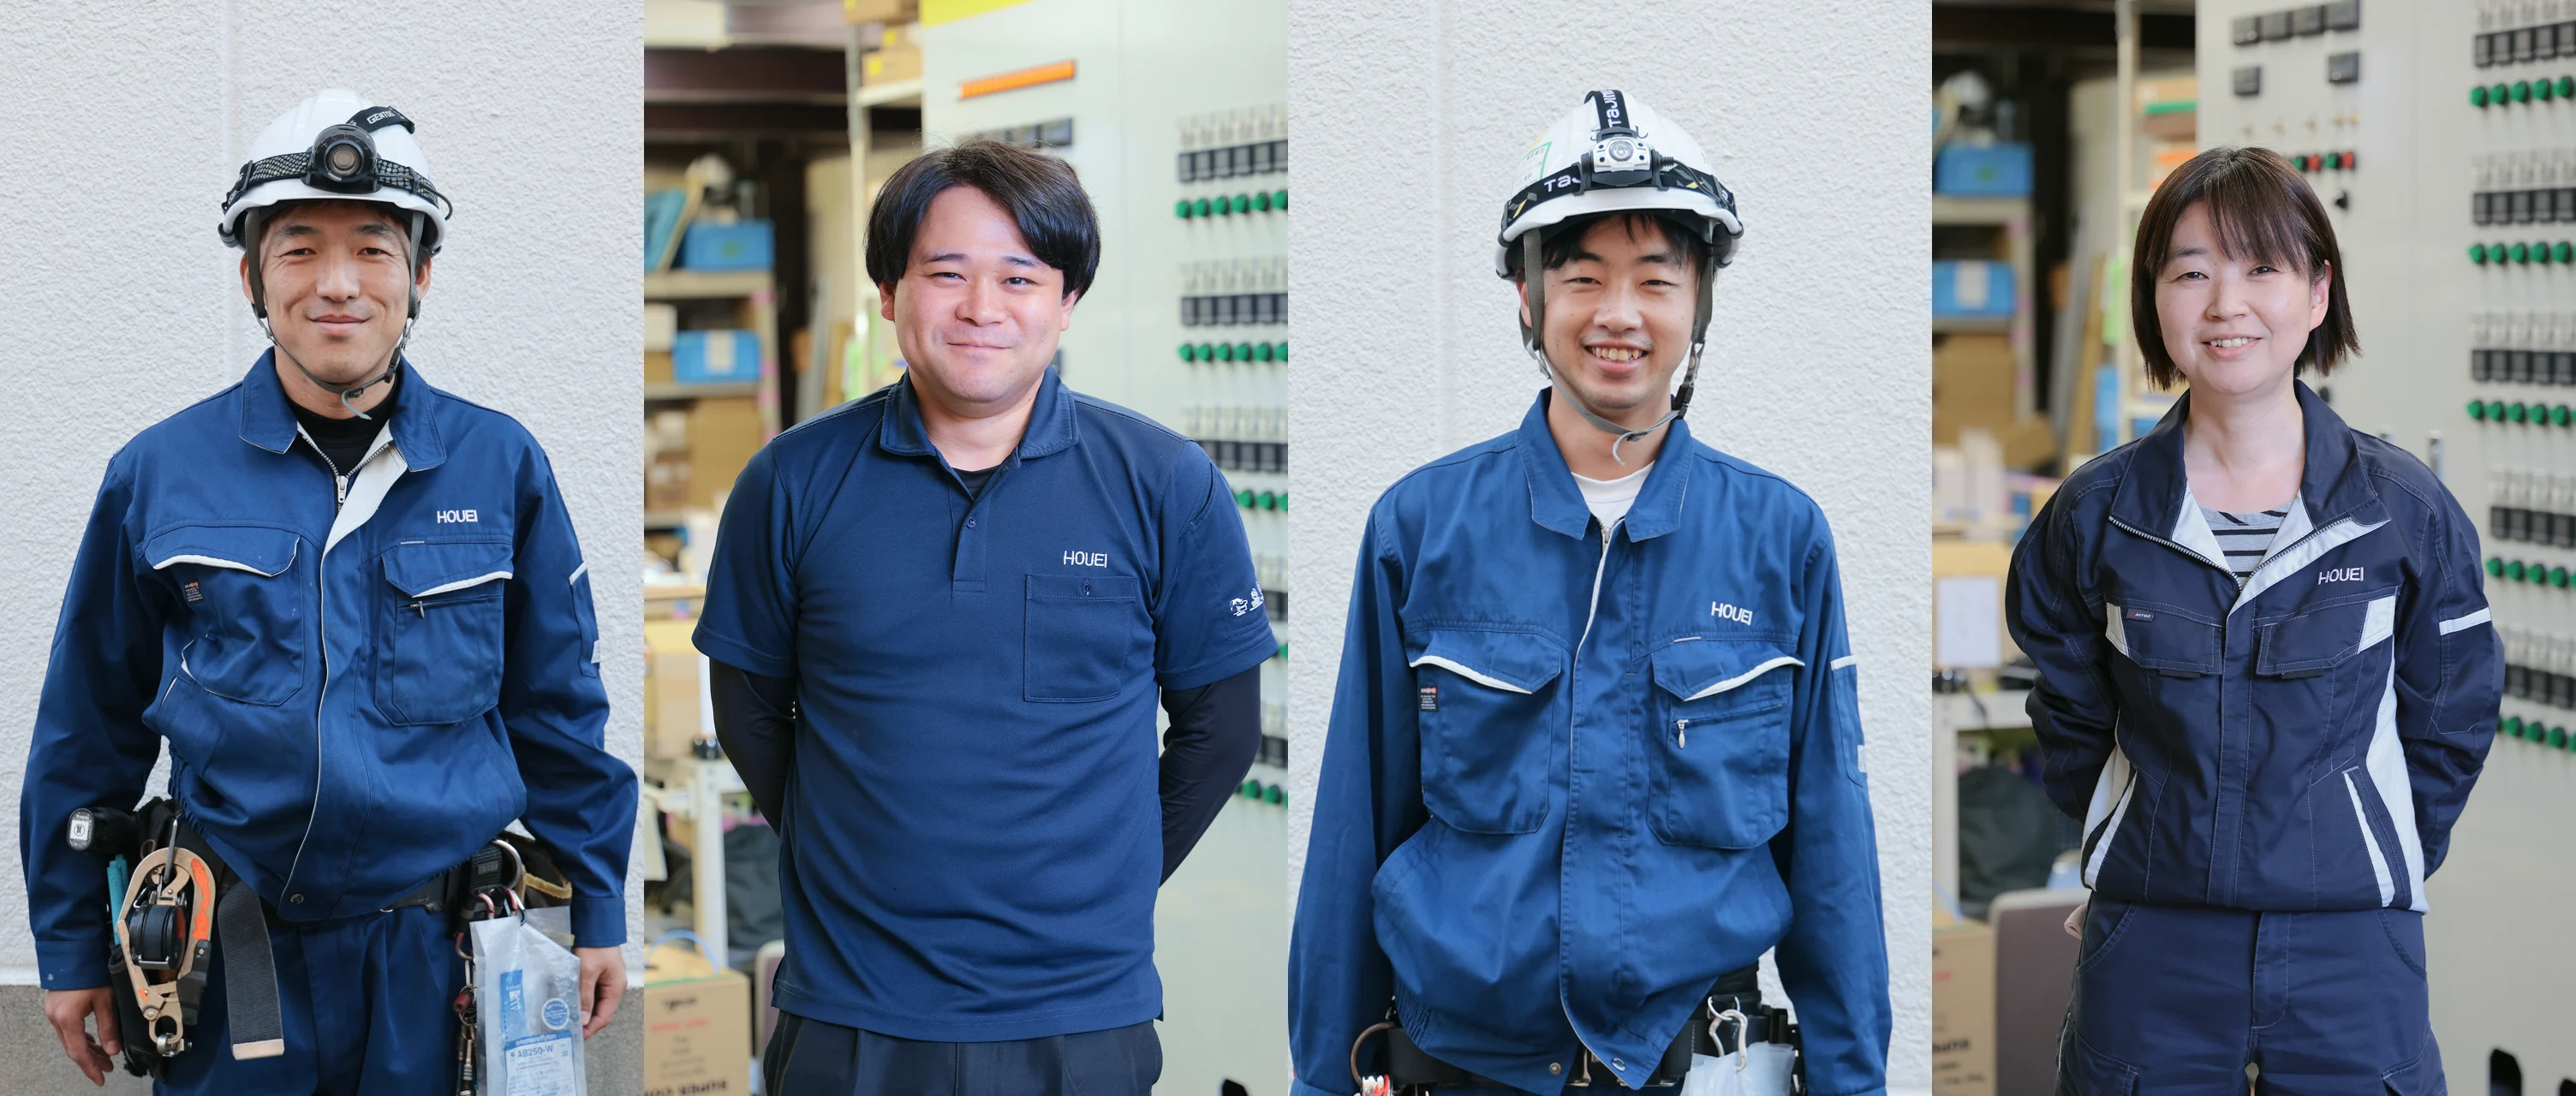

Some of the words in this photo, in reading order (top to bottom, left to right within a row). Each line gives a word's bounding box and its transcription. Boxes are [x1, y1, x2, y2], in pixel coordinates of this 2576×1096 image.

[367, 110, 395, 124] GENTOS
[437, 509, 478, 523] HOUEI
[1063, 550, 1107, 568] HOUEI
[2317, 567, 2364, 585] HOUEI
[1711, 601, 1753, 626] HOUEI
[517, 1045, 554, 1058] AB250-W
